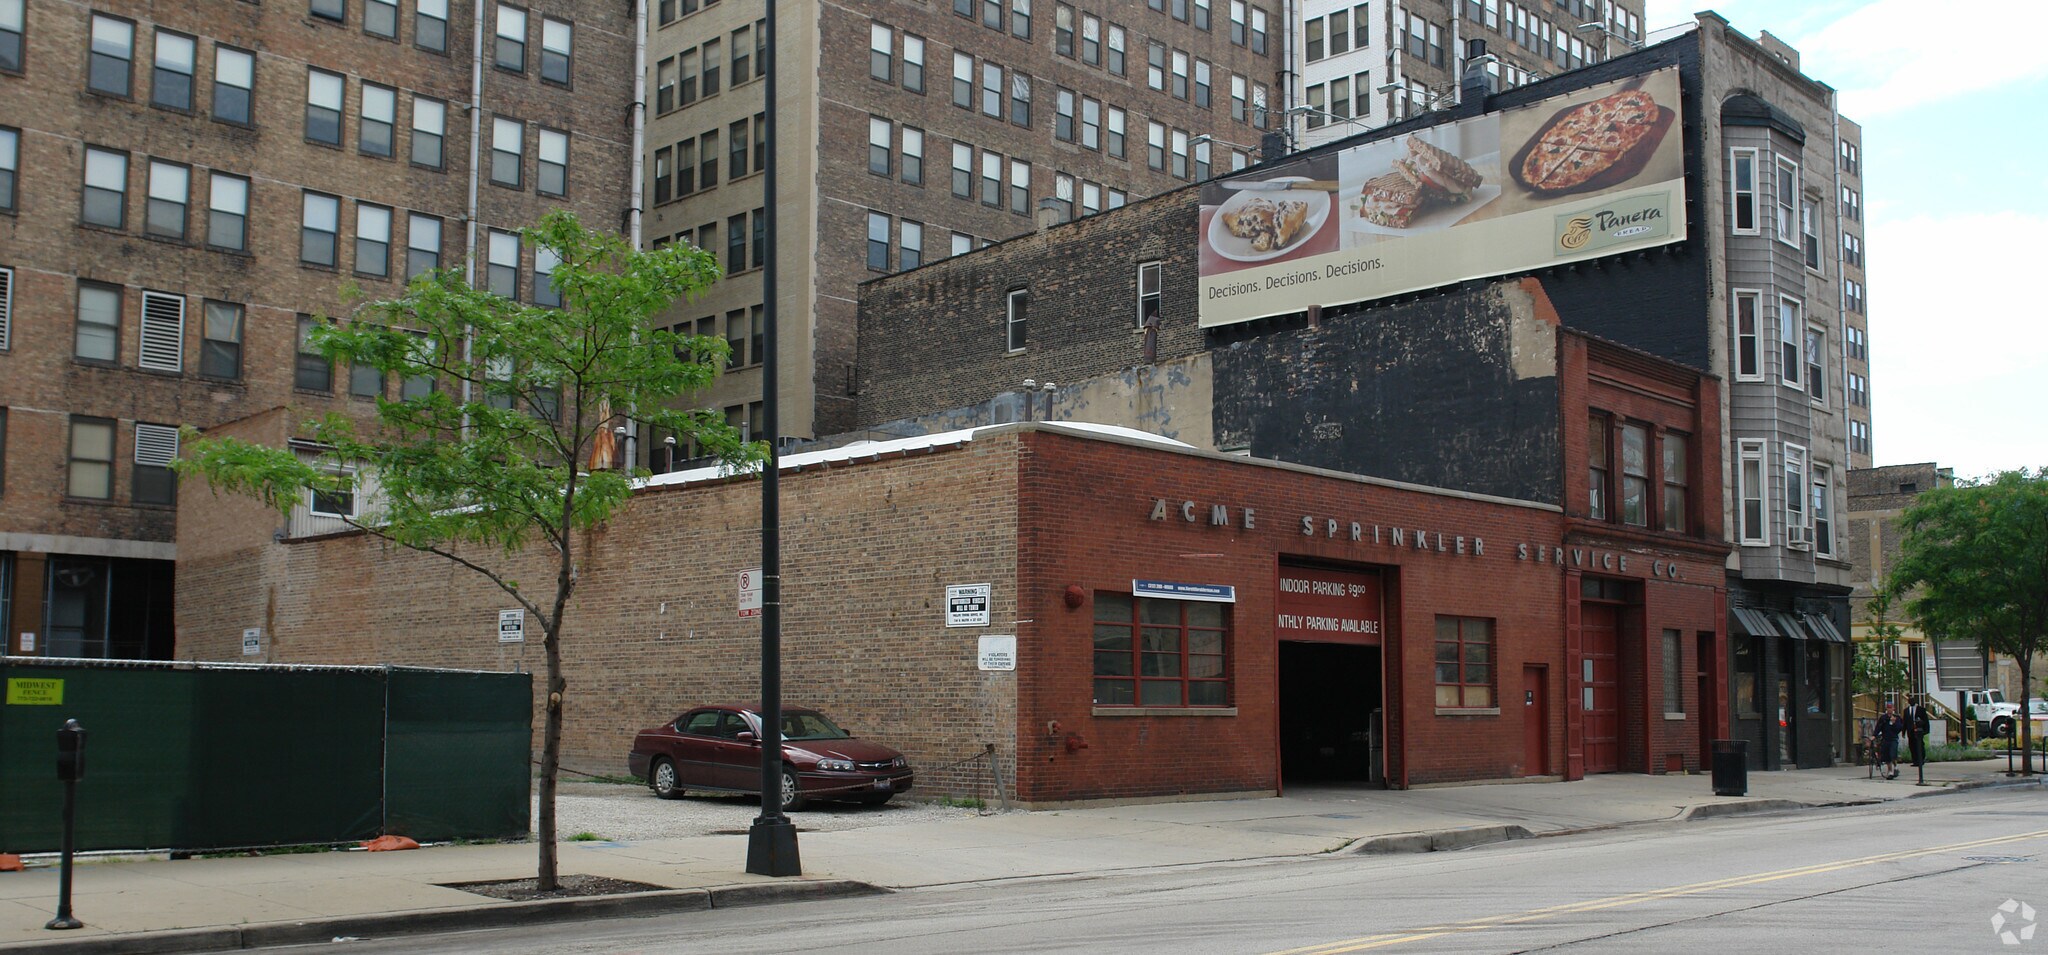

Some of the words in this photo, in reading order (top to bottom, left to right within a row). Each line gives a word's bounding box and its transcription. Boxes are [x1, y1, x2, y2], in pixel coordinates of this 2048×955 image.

[1595, 207, 1662, 231] Panera
[1617, 226, 1647, 236] BREAD
[1209, 281, 1262, 300] Decisions.
[1266, 269, 1322, 290] Decisions.
[1326, 258, 1385, 279] Decisions.
[1151, 499, 1256, 529] ACME
[1302, 516, 1485, 556] SPRINKLER
[1518, 543, 1627, 572] SERVICE
[1280, 578, 1310, 594] INDOOR
[1312, 581, 1346, 597] PARKING
[1306, 616, 1339, 631] PARKING
[1341, 618, 1379, 634] AVAILABLE
[16, 681, 56, 689] MIDWEST
